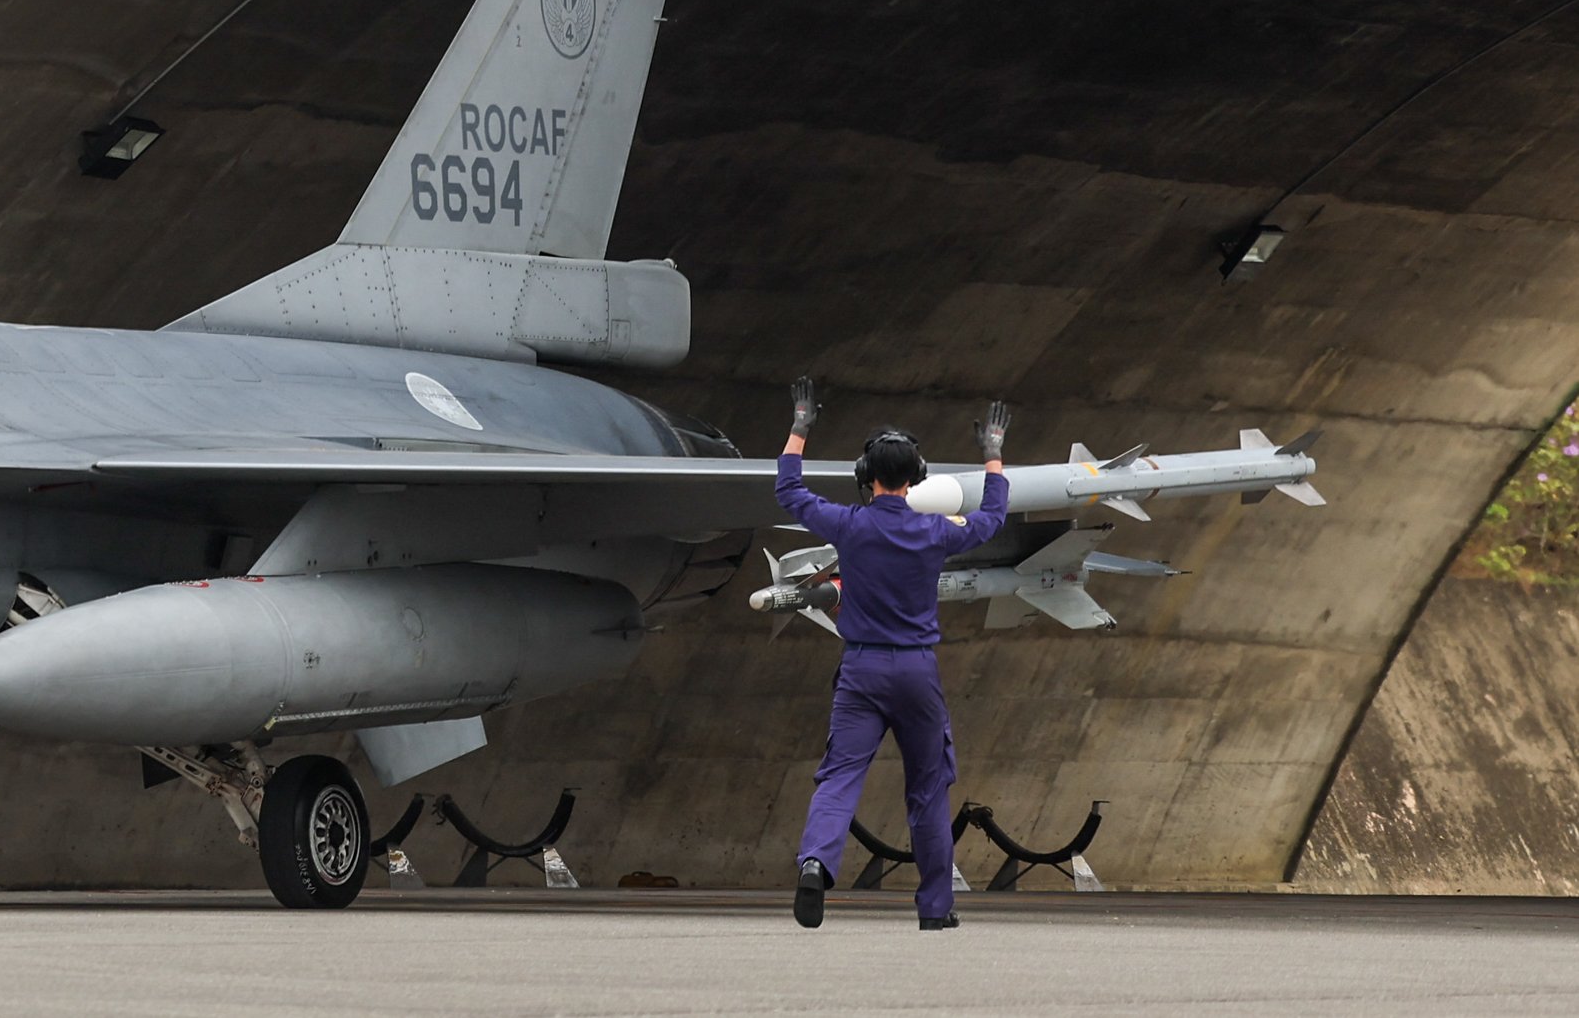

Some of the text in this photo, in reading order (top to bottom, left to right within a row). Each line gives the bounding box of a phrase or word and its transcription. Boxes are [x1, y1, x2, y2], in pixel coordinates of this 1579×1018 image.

[565, 22, 574, 42] 4
[460, 103, 567, 156] ROCAF
[410, 154, 523, 226] 6694
